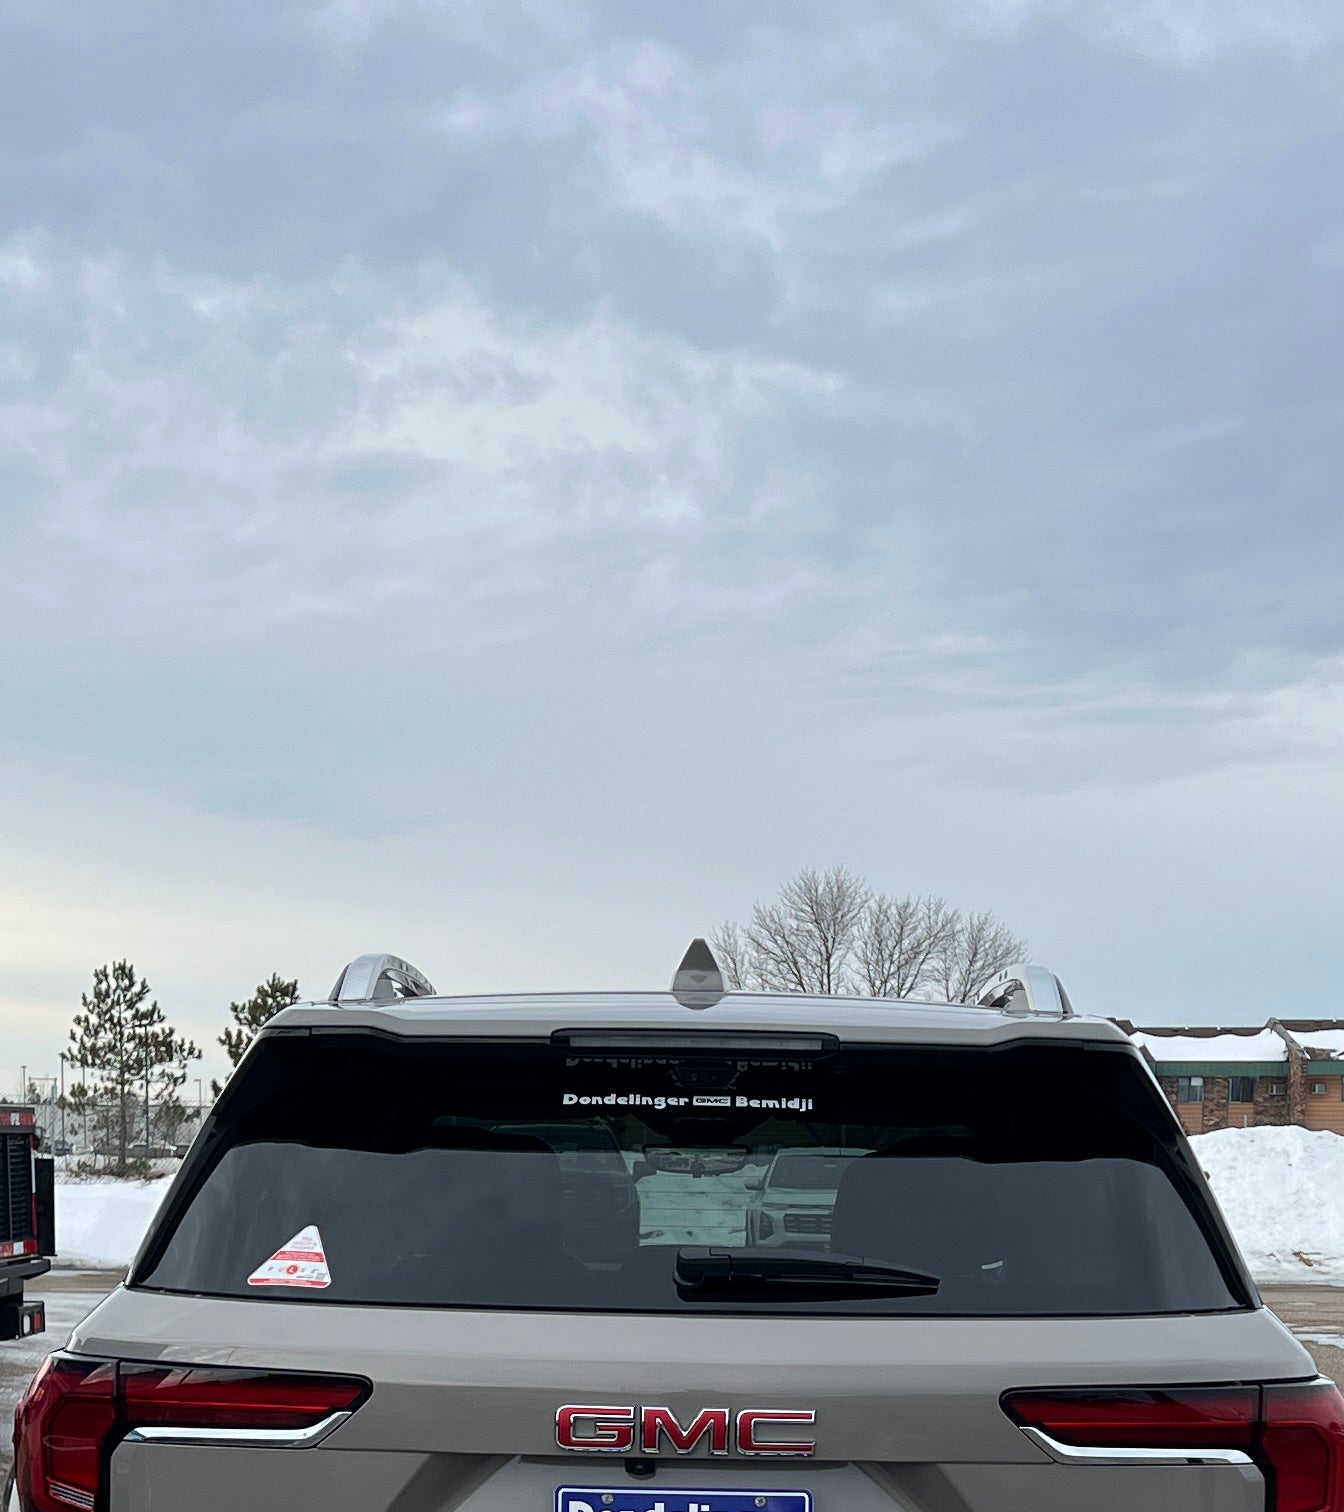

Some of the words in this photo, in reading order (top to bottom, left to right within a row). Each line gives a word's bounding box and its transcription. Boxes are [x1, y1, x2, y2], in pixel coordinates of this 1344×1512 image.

[562, 1093, 689, 1110] Dondelinger
[694, 1096, 730, 1106] GMC
[735, 1096, 814, 1112] Bemidji
[556, 1404, 816, 1456] GMC
